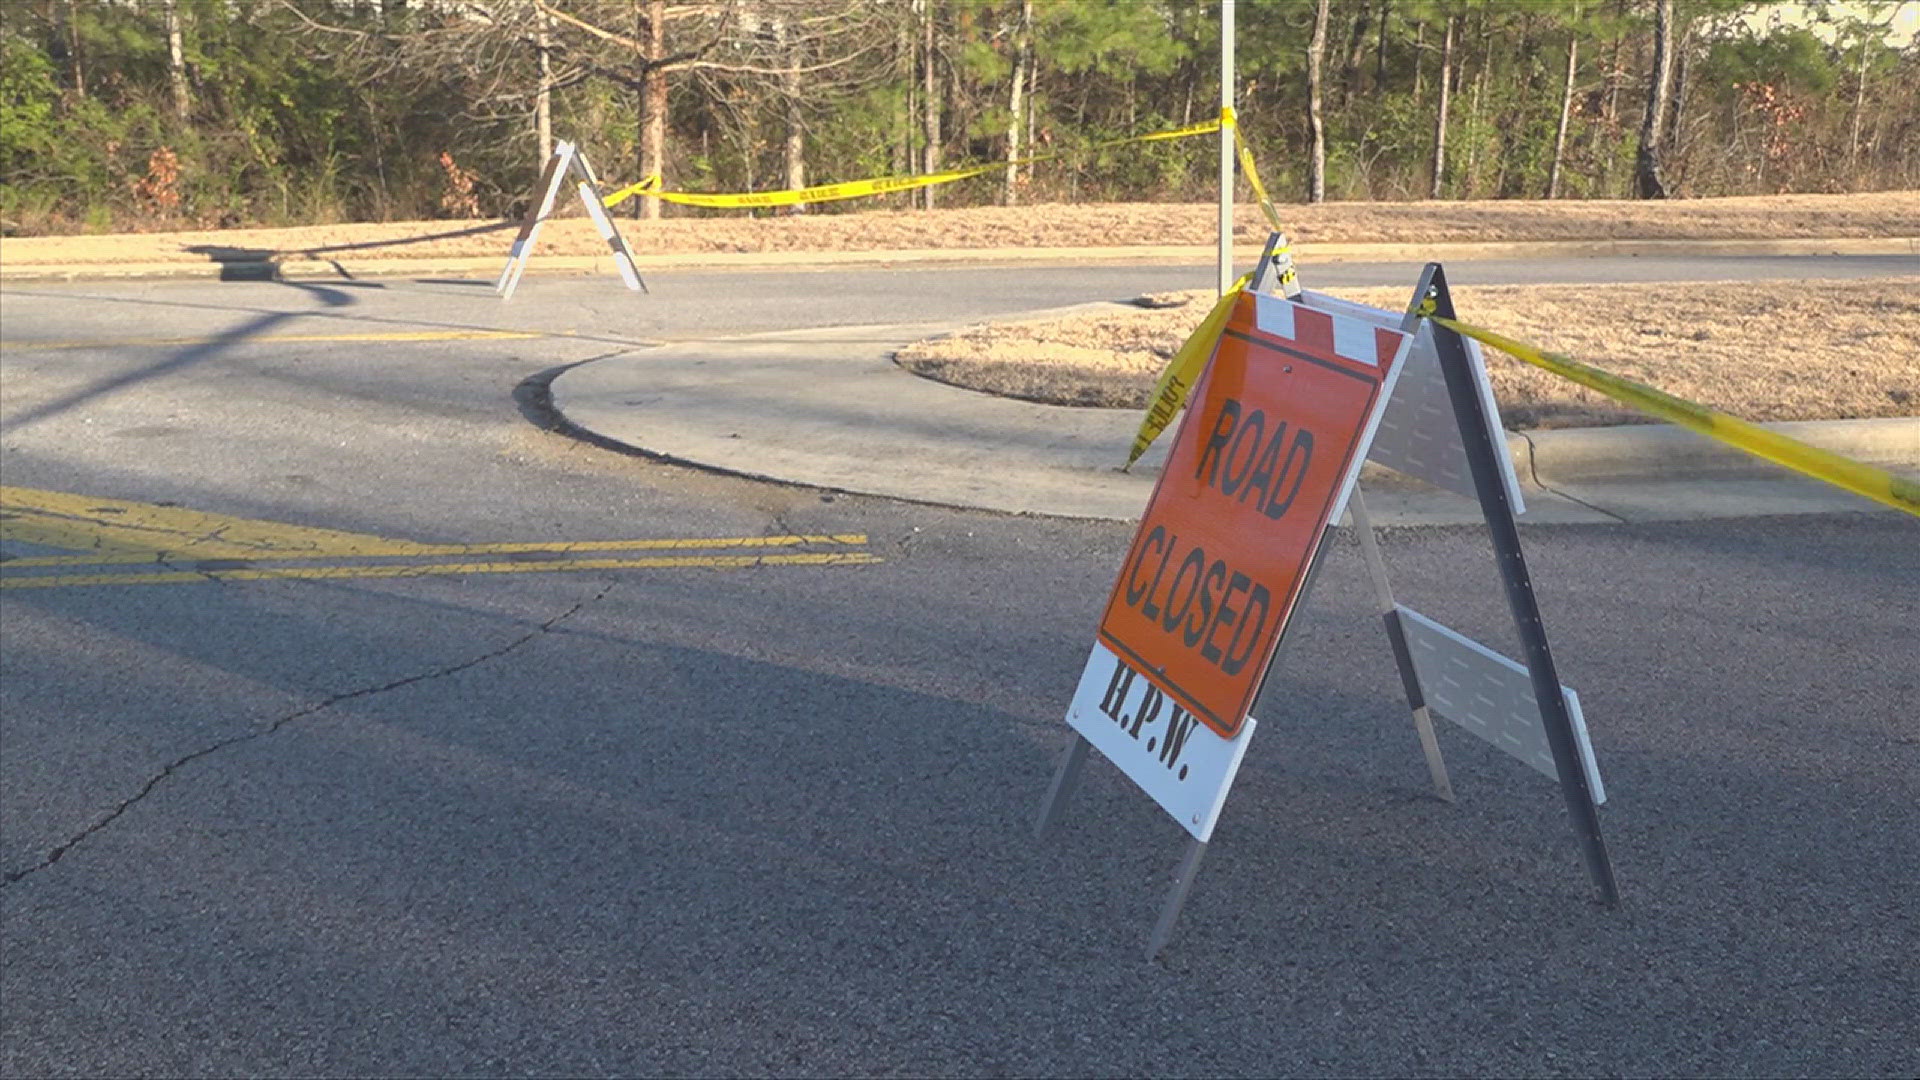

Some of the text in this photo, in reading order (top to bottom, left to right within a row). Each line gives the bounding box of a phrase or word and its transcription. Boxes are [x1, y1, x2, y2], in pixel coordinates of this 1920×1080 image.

[1195, 398, 1314, 520] ROAD
[1126, 525, 1271, 676] CLOSED
[1099, 658, 1199, 781] H.P.W.
